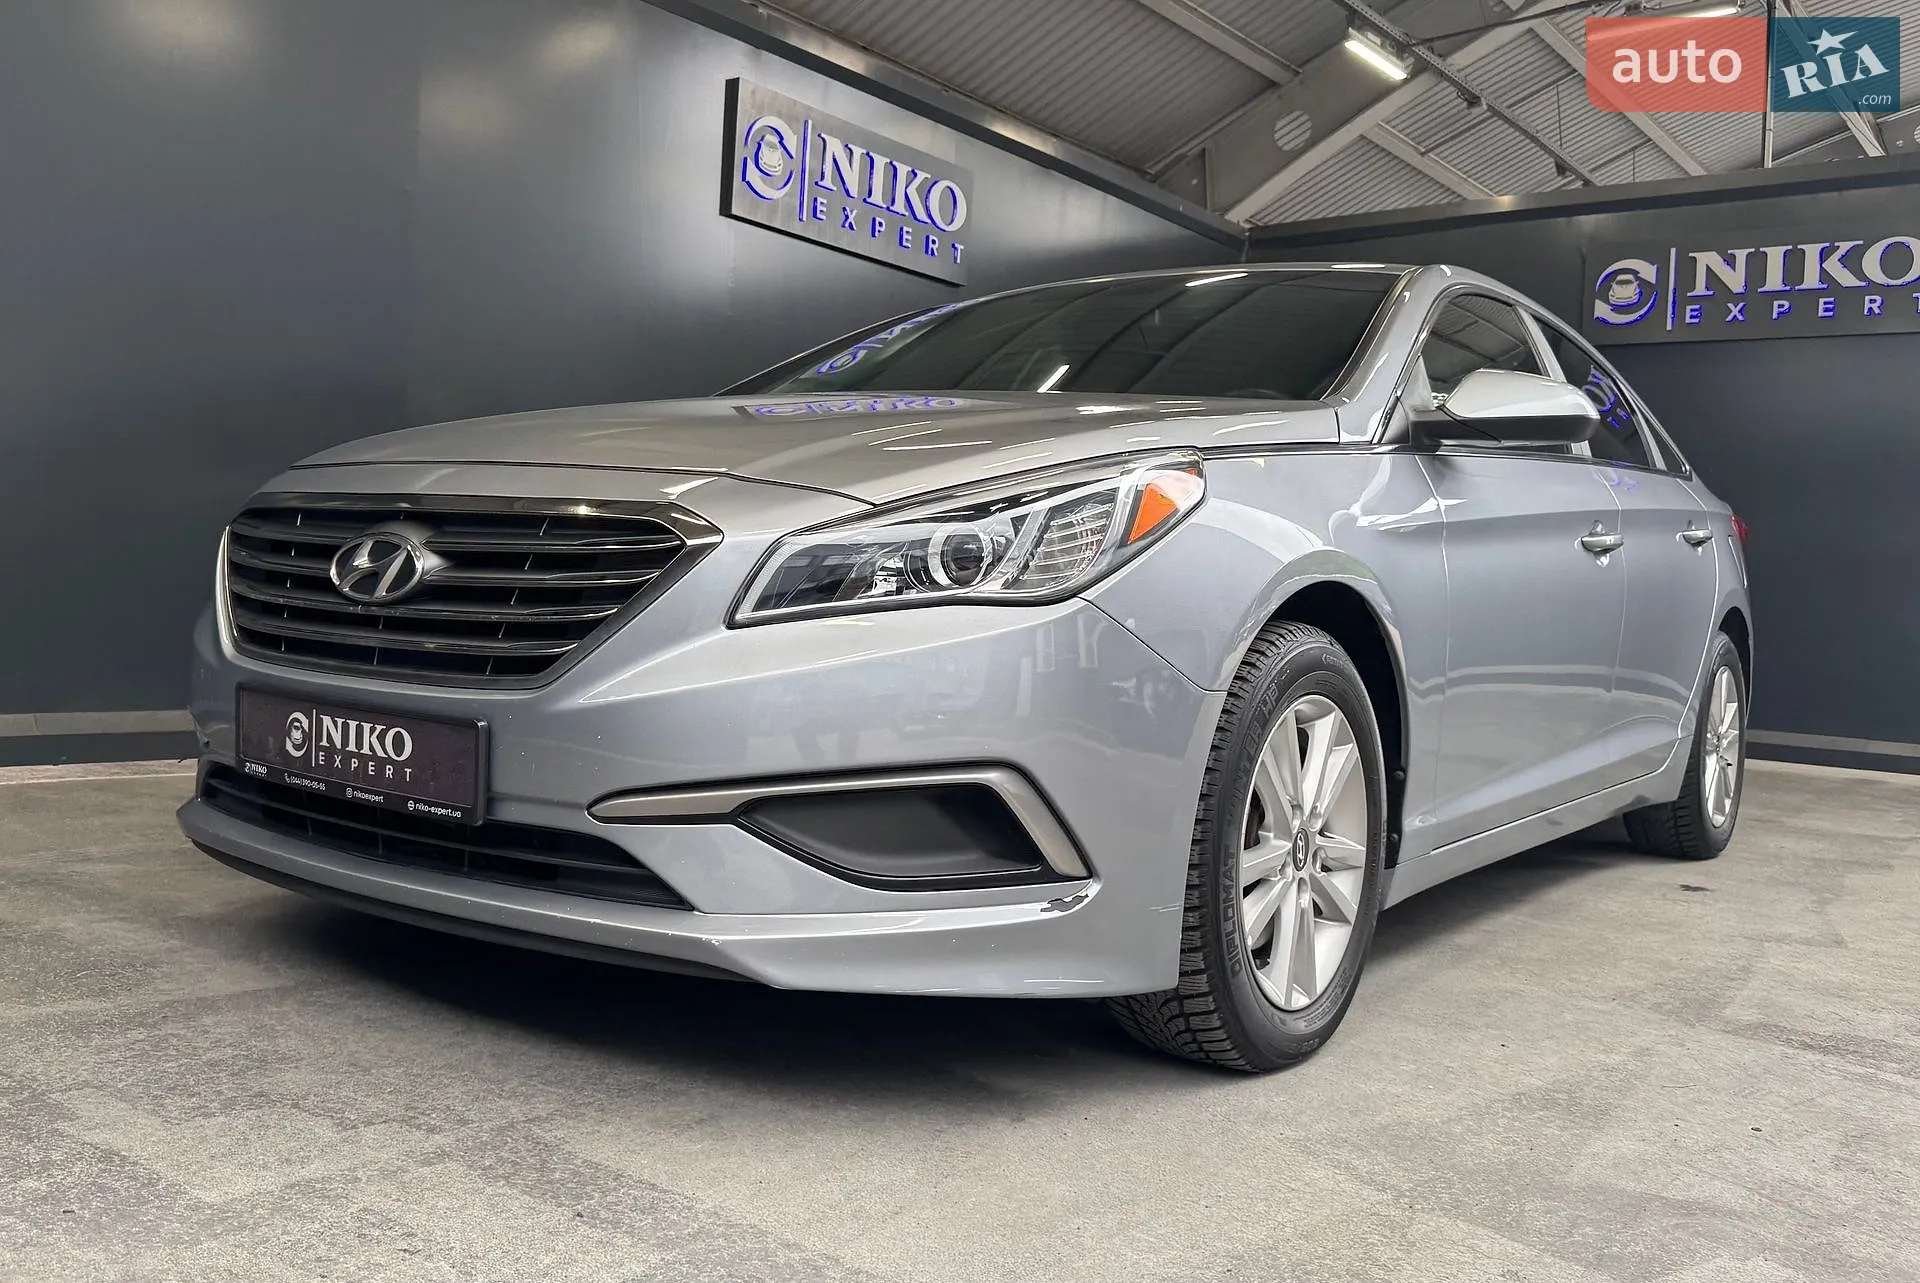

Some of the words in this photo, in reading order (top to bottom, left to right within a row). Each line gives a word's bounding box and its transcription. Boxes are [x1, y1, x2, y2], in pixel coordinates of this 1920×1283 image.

[814, 132, 967, 232] NIKO
[812, 196, 964, 264] EXPERT
[1687, 236, 1920, 296] NIKO
[319, 714, 413, 761] NIKO
[251, 763, 268, 774] NIKO
[319, 754, 413, 782] EXPERT
[353, 790, 384, 803] nikoexpert
[1220, 845, 1241, 978] DIPLOMAT
